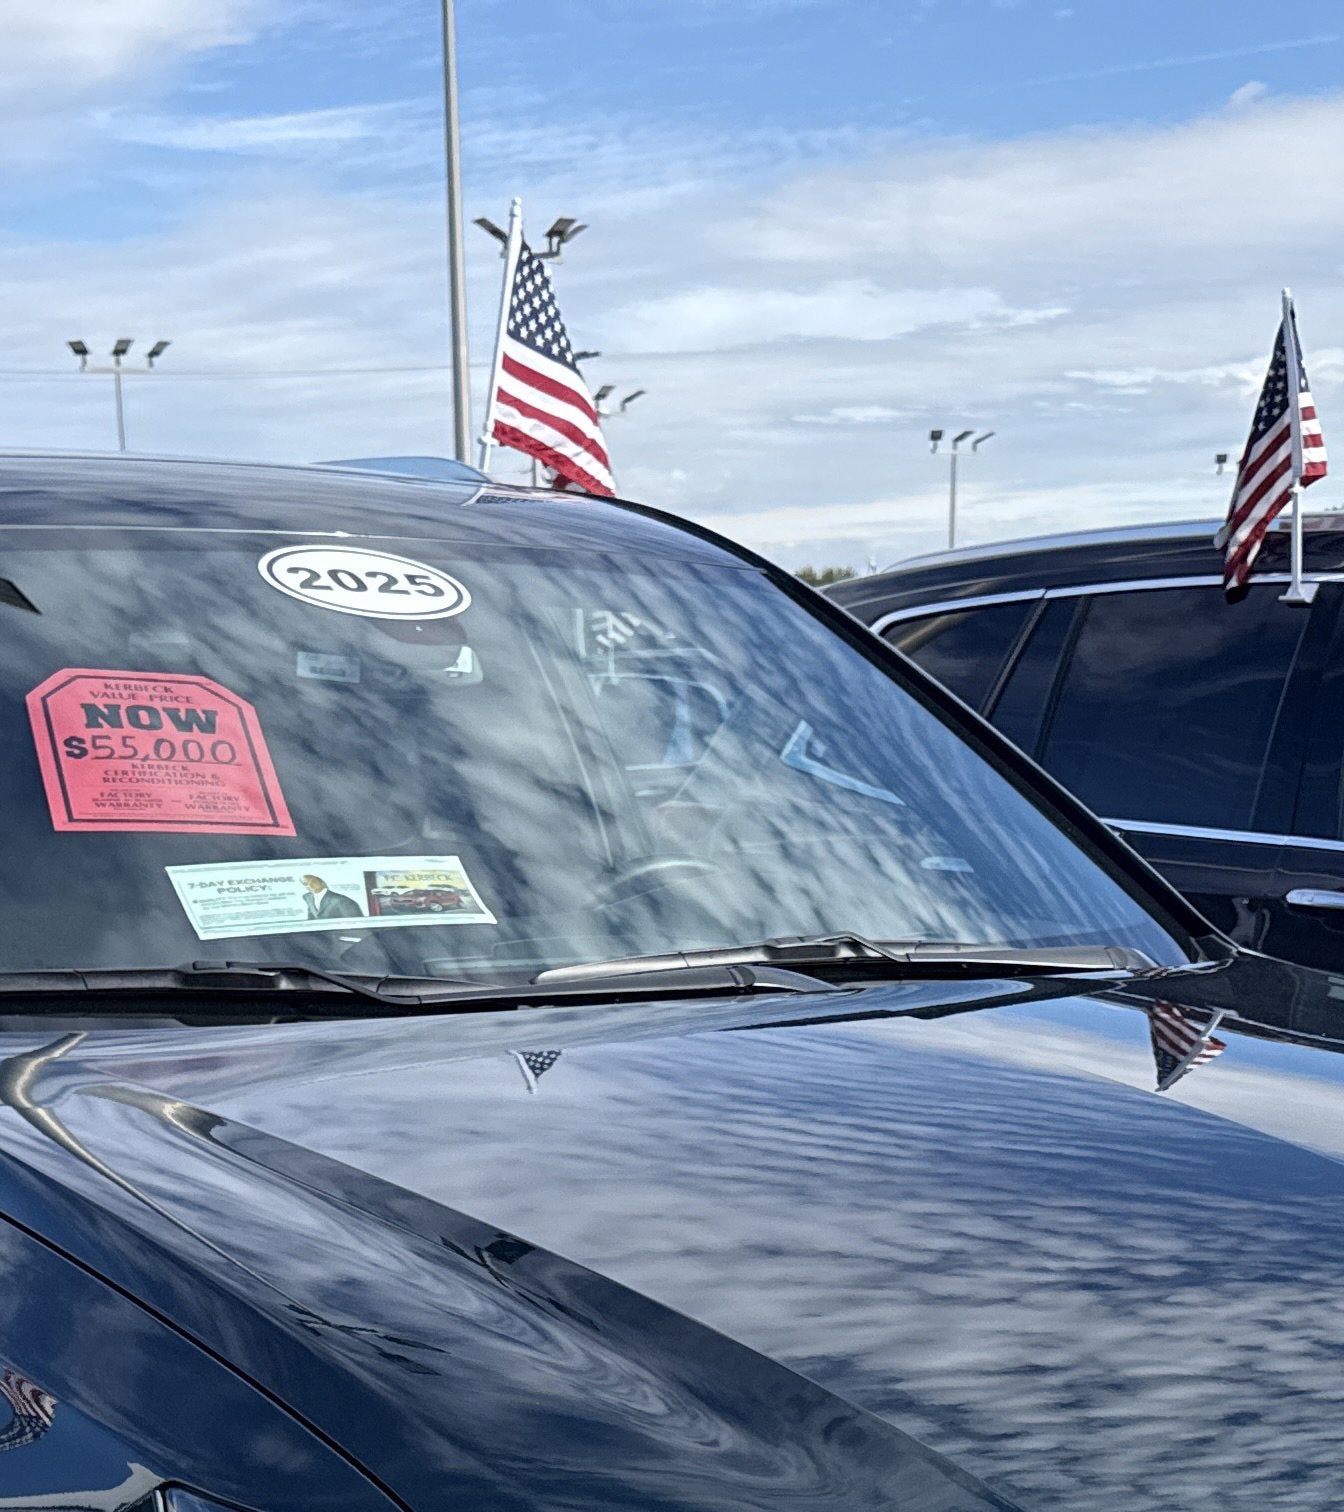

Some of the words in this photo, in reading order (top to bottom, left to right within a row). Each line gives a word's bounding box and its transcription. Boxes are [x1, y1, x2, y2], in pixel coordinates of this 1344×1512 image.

[286, 566, 445, 597] 2025
[103, 682, 174, 693] KERBECK
[89, 690, 137, 700] VALUE
[149, 694, 193, 704] PRICE
[80, 703, 218, 735] NOW
[63, 735, 237, 764] $55,000
[131, 763, 190, 772] KERBECK
[103, 769, 206, 779] CERTIFICATION
[102, 777, 227, 787] RECONDITIONING
[94, 801, 163, 809] WARRANTY
[187, 879, 225, 889] 7-DAY
[227, 876, 296, 886] EXCHANGE
